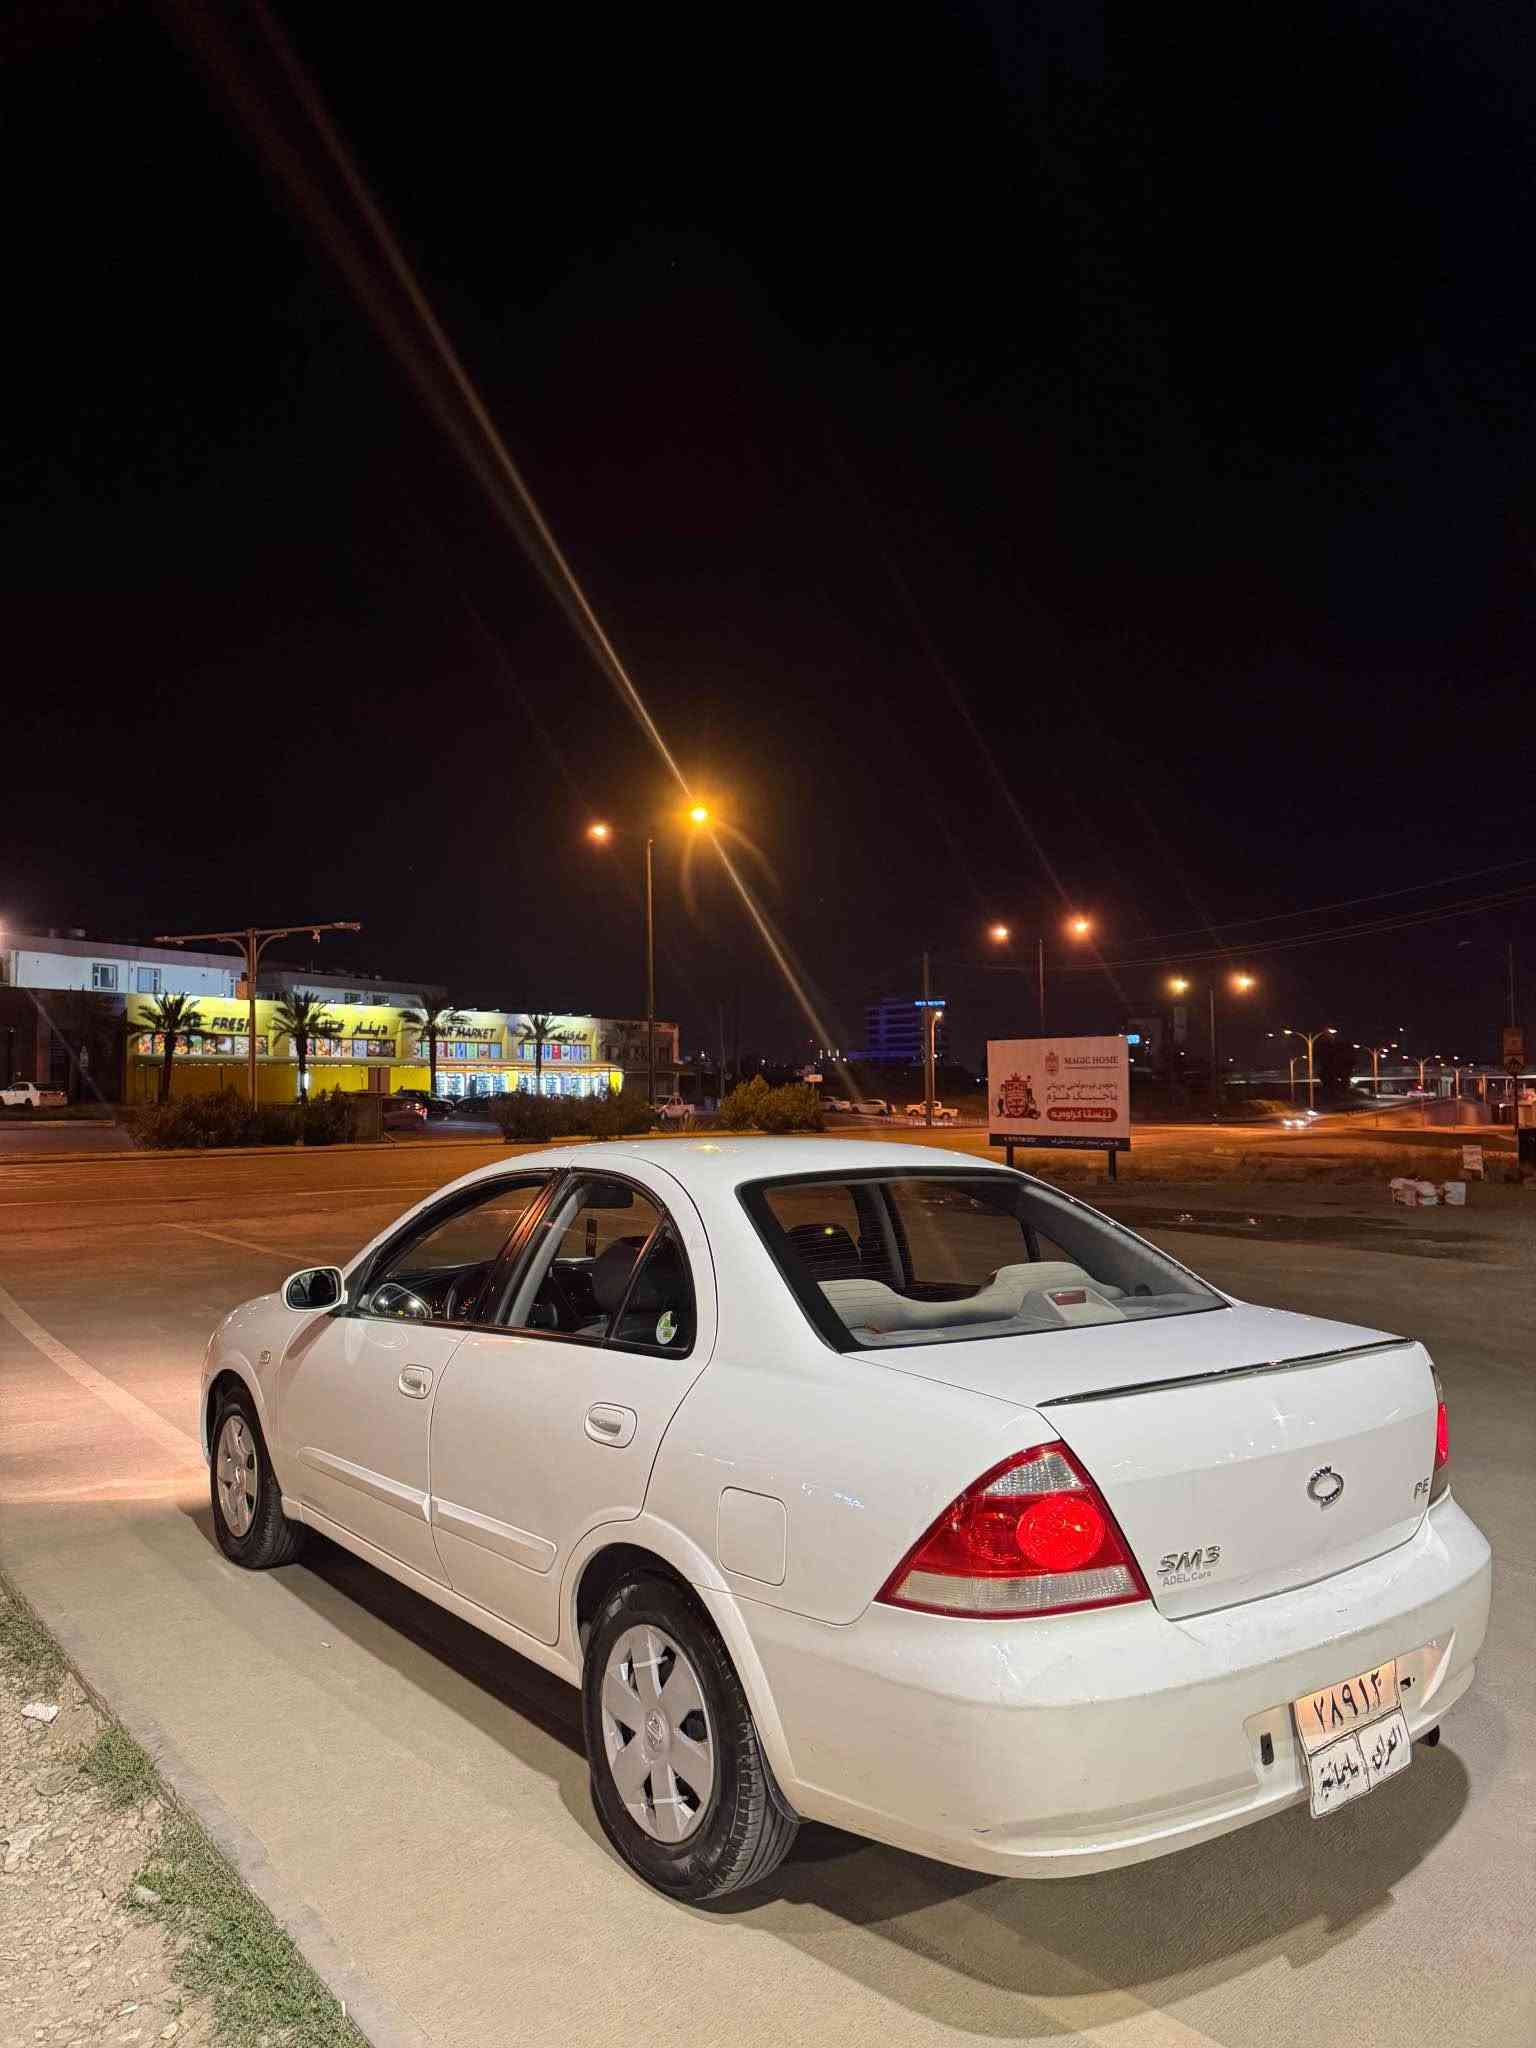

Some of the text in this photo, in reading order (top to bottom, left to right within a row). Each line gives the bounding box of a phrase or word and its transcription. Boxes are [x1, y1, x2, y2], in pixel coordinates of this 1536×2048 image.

[456, 1027, 497, 1042] MARKET
[1093, 1055, 1119, 1065] HOME
[1157, 1546, 1220, 1574] SM3
